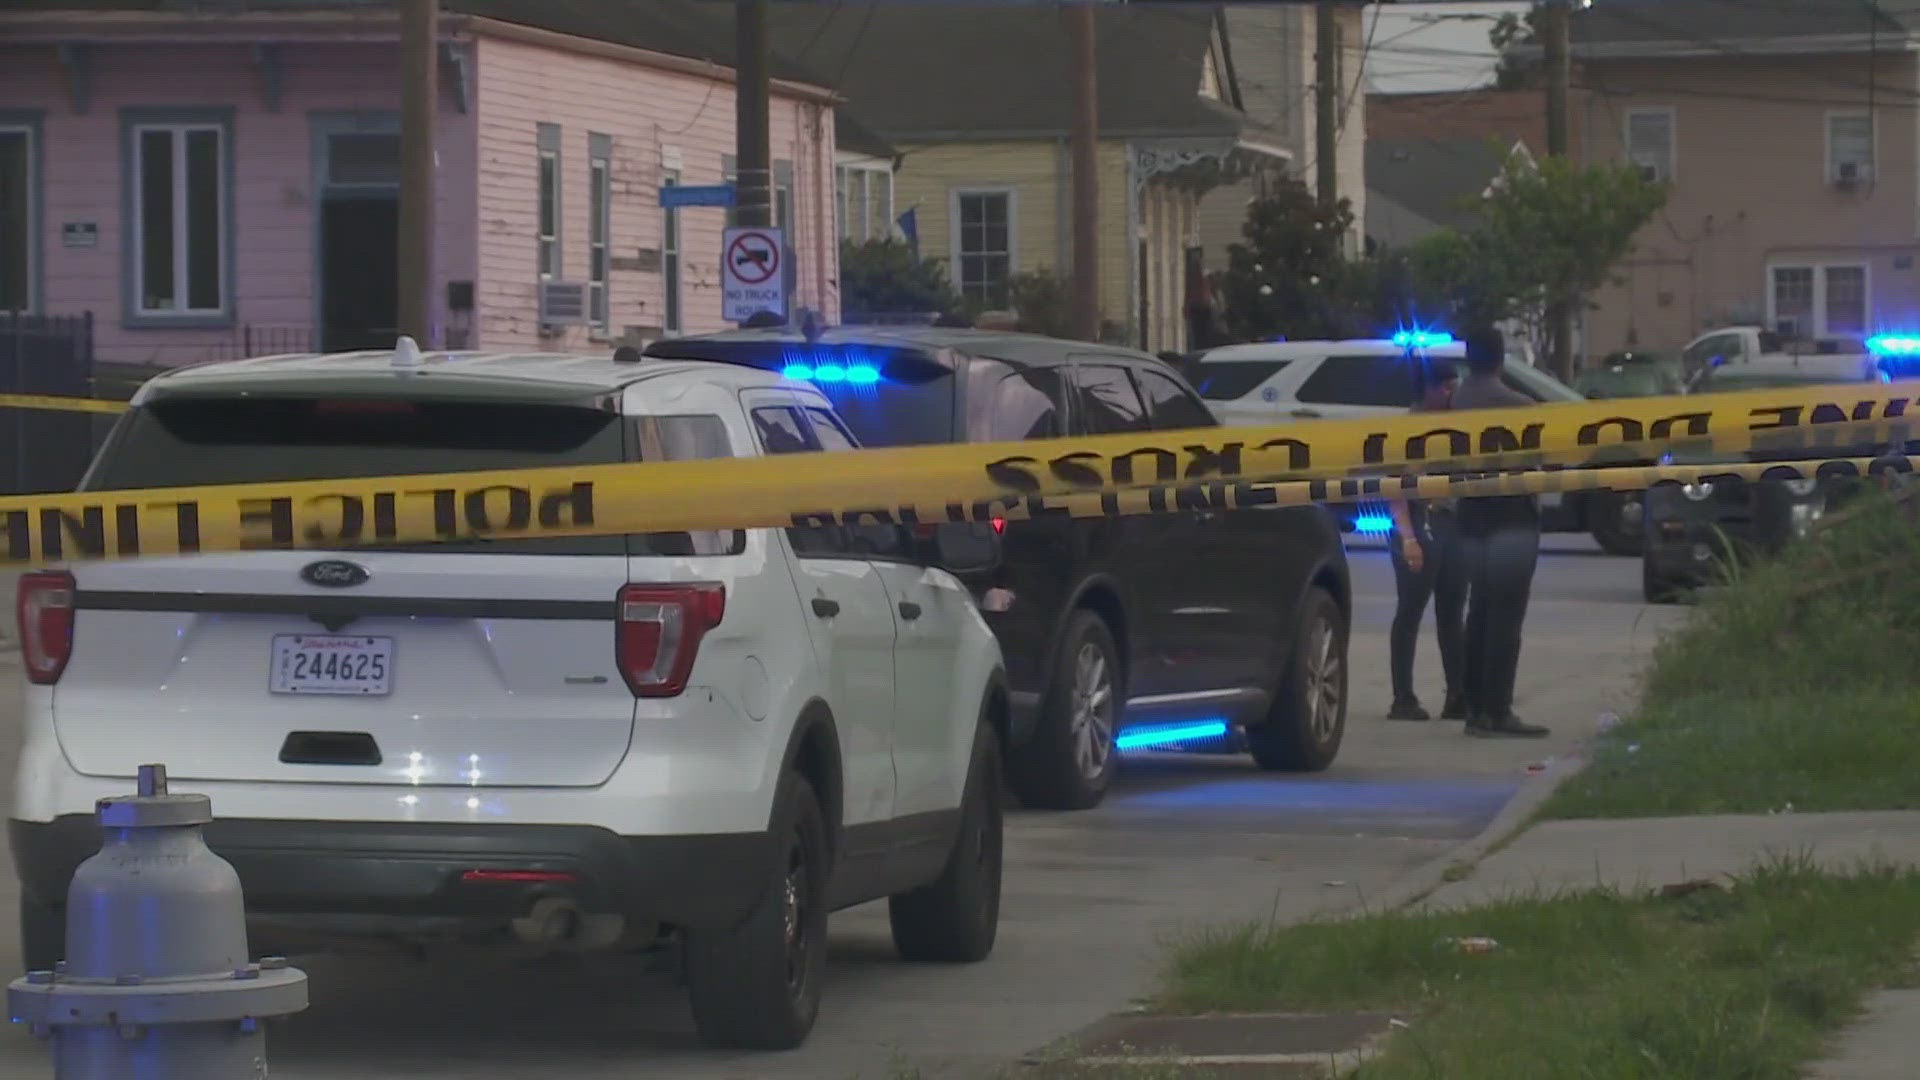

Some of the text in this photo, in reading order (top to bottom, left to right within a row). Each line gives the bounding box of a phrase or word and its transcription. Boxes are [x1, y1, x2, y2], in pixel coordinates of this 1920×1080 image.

[727, 290, 779, 301] NO TRUCK
[237, 481, 595, 550] POLICE
[313, 564, 353, 581] Ford
[293, 652, 385, 681] 244625
